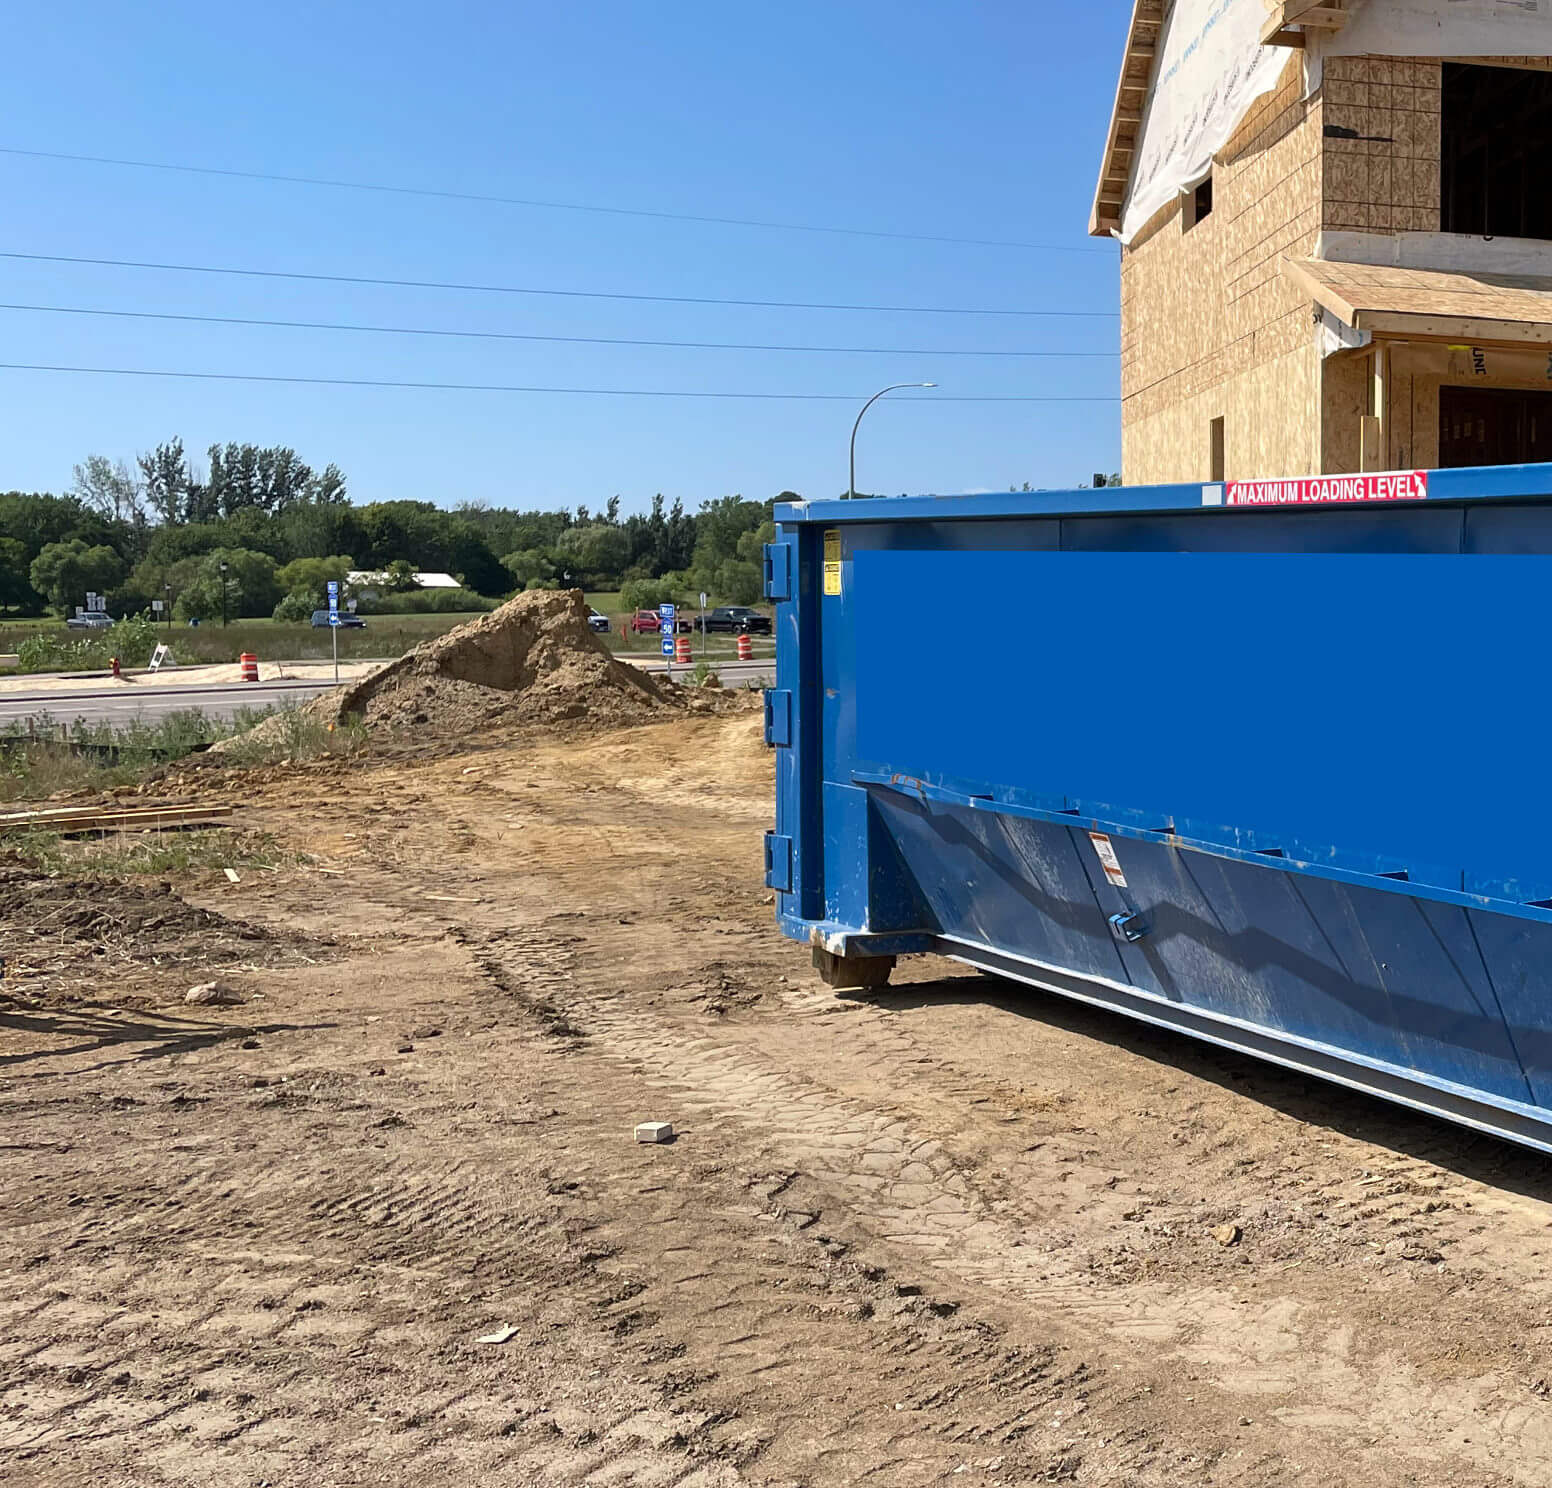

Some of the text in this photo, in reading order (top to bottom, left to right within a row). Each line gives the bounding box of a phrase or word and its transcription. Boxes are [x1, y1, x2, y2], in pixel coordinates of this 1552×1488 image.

[1237, 475, 1416, 504] MAXIMUM LOADING LEVEL
